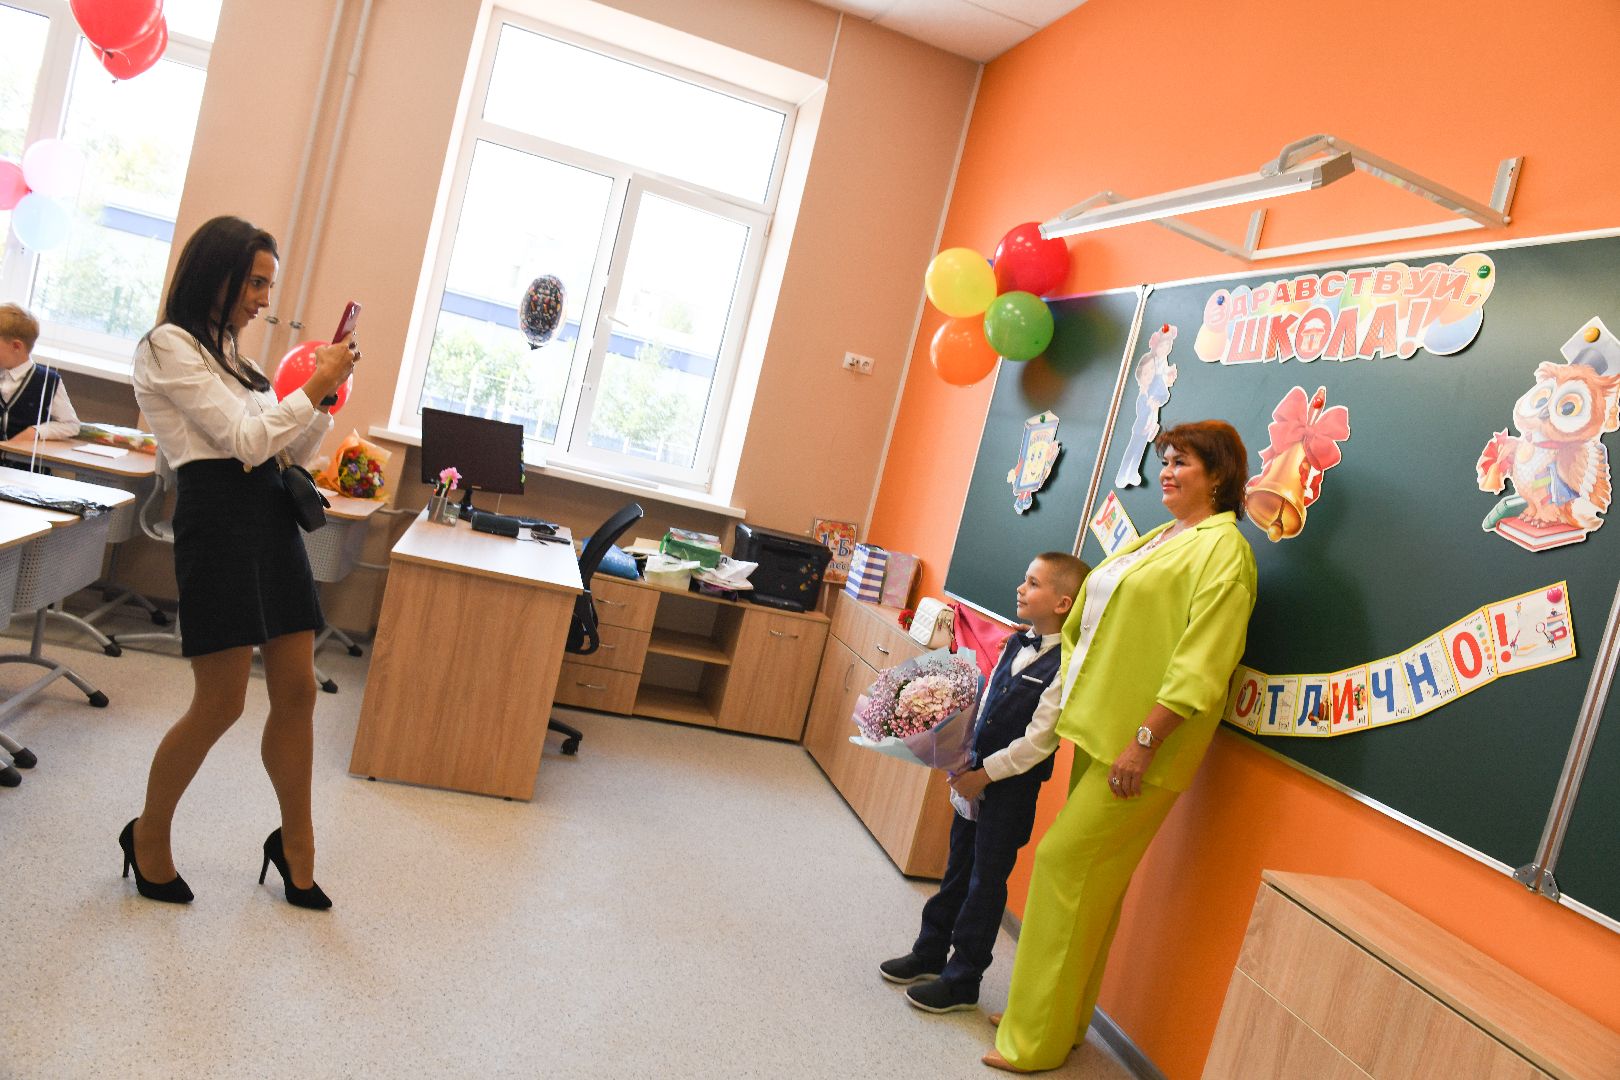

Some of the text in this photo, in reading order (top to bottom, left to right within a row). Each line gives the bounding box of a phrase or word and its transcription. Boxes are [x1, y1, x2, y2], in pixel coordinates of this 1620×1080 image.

[1208, 267, 1482, 325] ЗДРАВСТВУЙ,
[1227, 300, 1427, 360] ШКОЛА!
[1235, 612, 1512, 726] ОТЛИЧНО!
